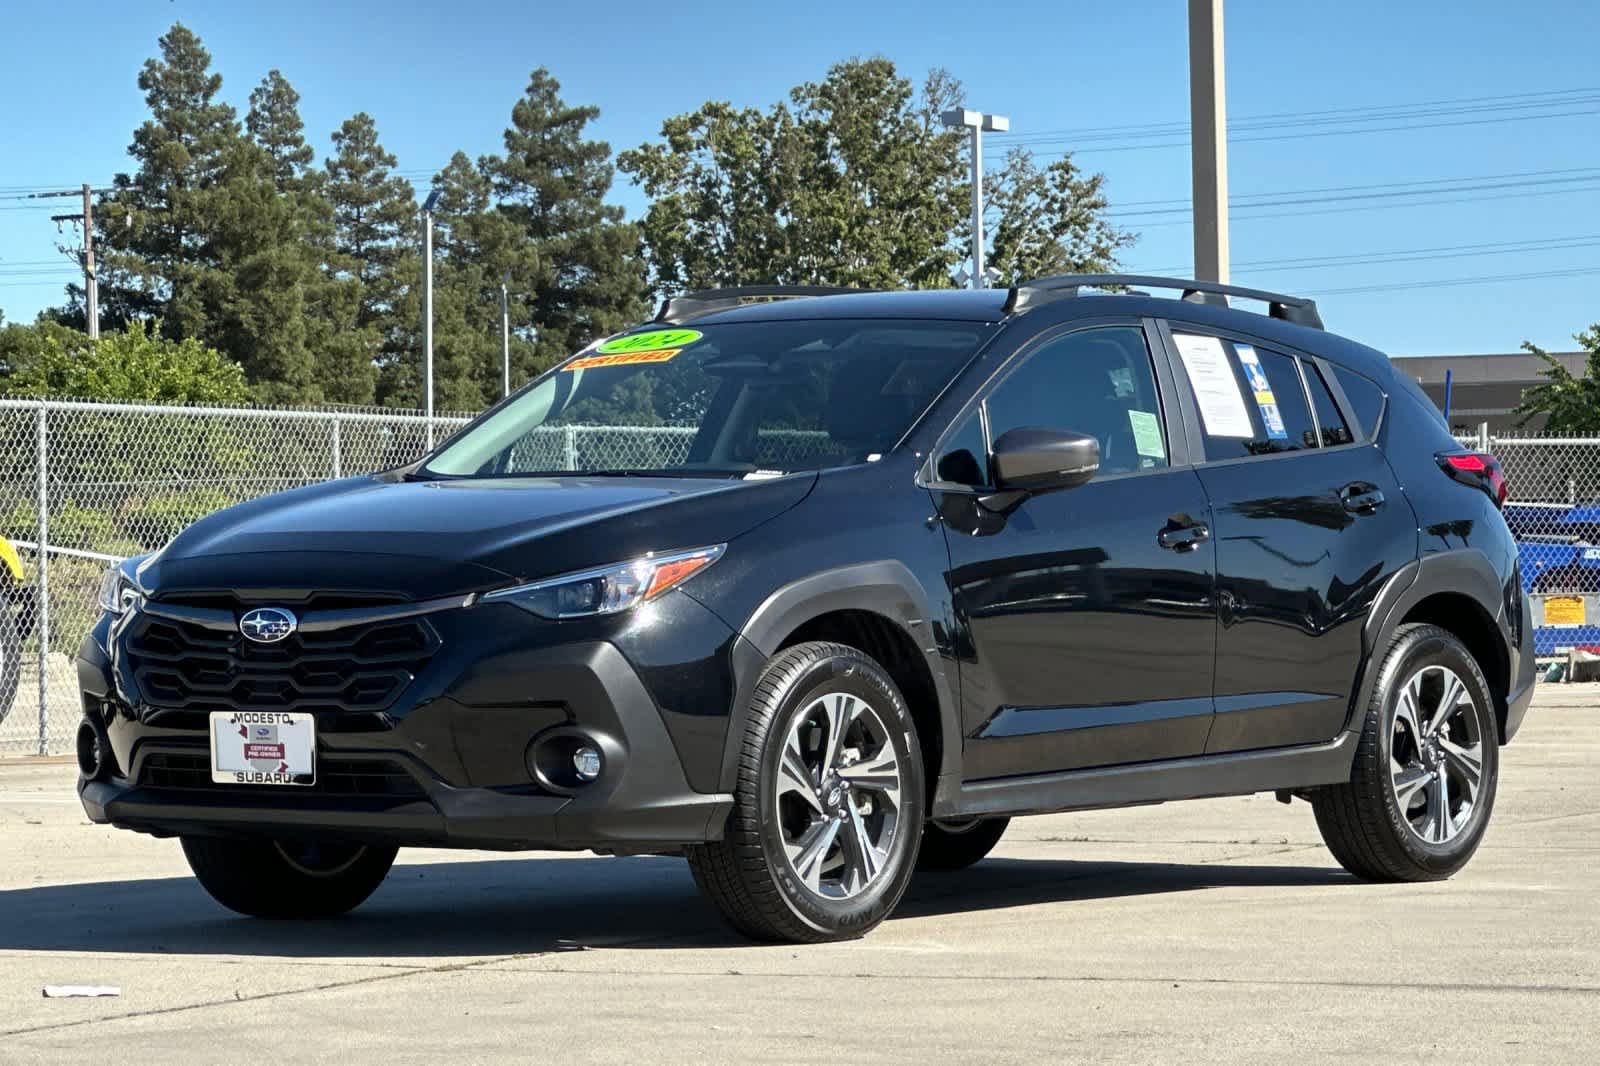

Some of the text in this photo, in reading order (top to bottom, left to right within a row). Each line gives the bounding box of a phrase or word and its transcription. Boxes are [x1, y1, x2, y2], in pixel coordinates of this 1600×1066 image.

[563, 350, 677, 369] CERTIFIED
[233, 712, 290, 724] MODESTO
[236, 771, 291, 783] SUBARU
